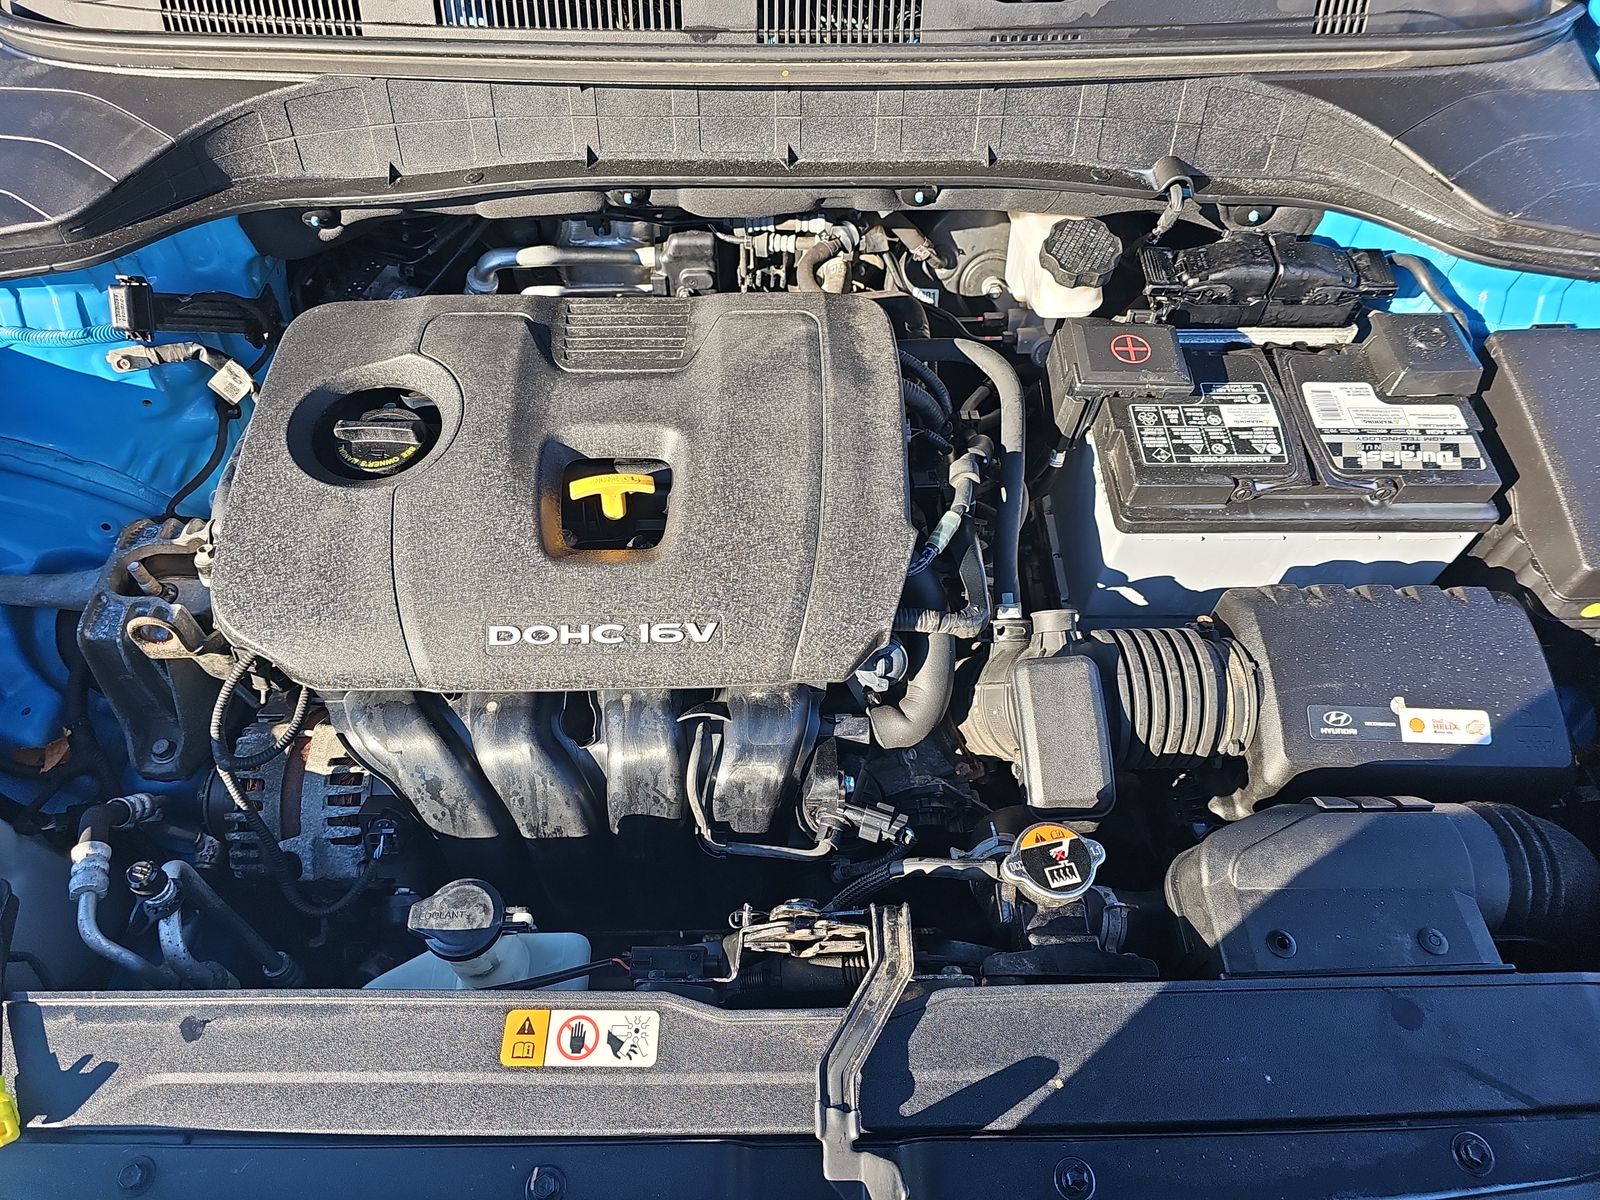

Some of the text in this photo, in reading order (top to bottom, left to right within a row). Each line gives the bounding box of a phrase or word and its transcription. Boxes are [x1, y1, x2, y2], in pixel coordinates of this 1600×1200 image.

[401, 446, 417, 458] SEE
[360, 456, 400, 467] OWNER'S
[1356, 450, 1461, 466] Duralast
[488, 622, 720, 646] DOHC 16V
[1320, 727, 1358, 735] HYUNDAI
[1432, 722, 1460, 731] HELIX
[419, 910, 467, 920] COOLANT
